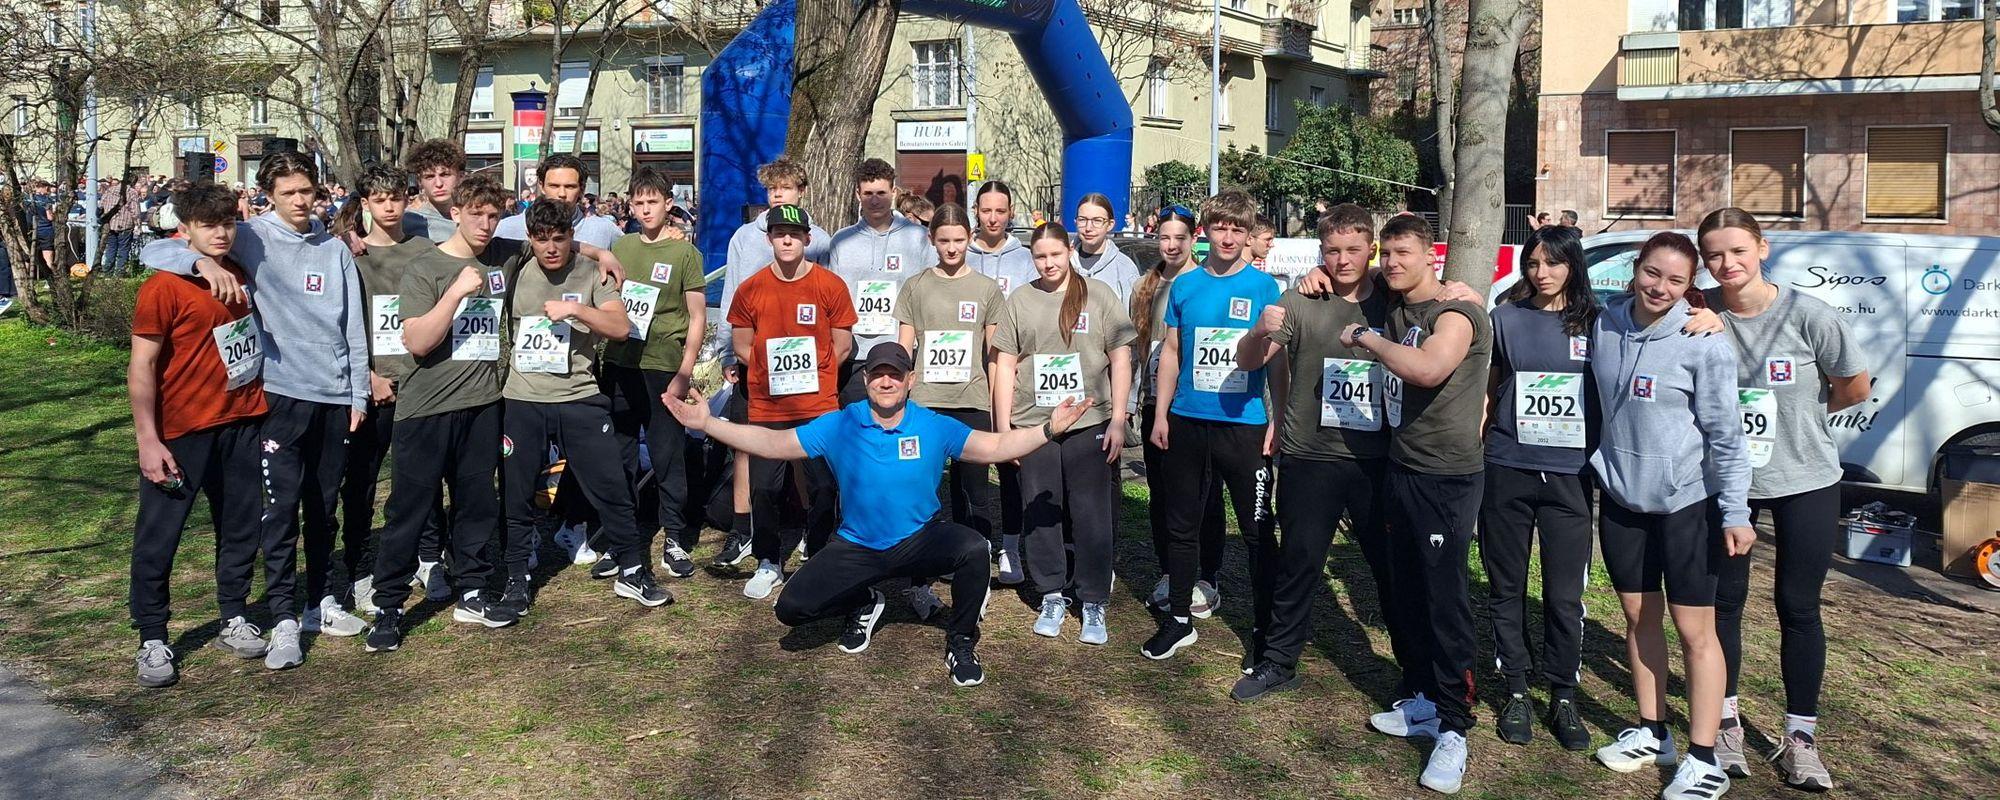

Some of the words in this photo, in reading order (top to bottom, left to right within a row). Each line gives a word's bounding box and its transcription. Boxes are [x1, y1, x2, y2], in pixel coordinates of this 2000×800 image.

[1791, 266, 1887, 290] Sipos
[858, 297, 891, 312] 2043
[1921, 307, 2000, 318] www.darkt
[380, 313, 401, 331] 20
[459, 316, 494, 335] 2051
[224, 334, 257, 364] 2047
[929, 348, 966, 366] 2037
[773, 352, 812, 372] 2038
[1039, 372, 1078, 391] 2045
[1329, 380, 1374, 403] 2041
[1384, 374, 1399, 398] 40
[1524, 394, 1577, 417] 2052
[1743, 412, 1768, 436] 59
